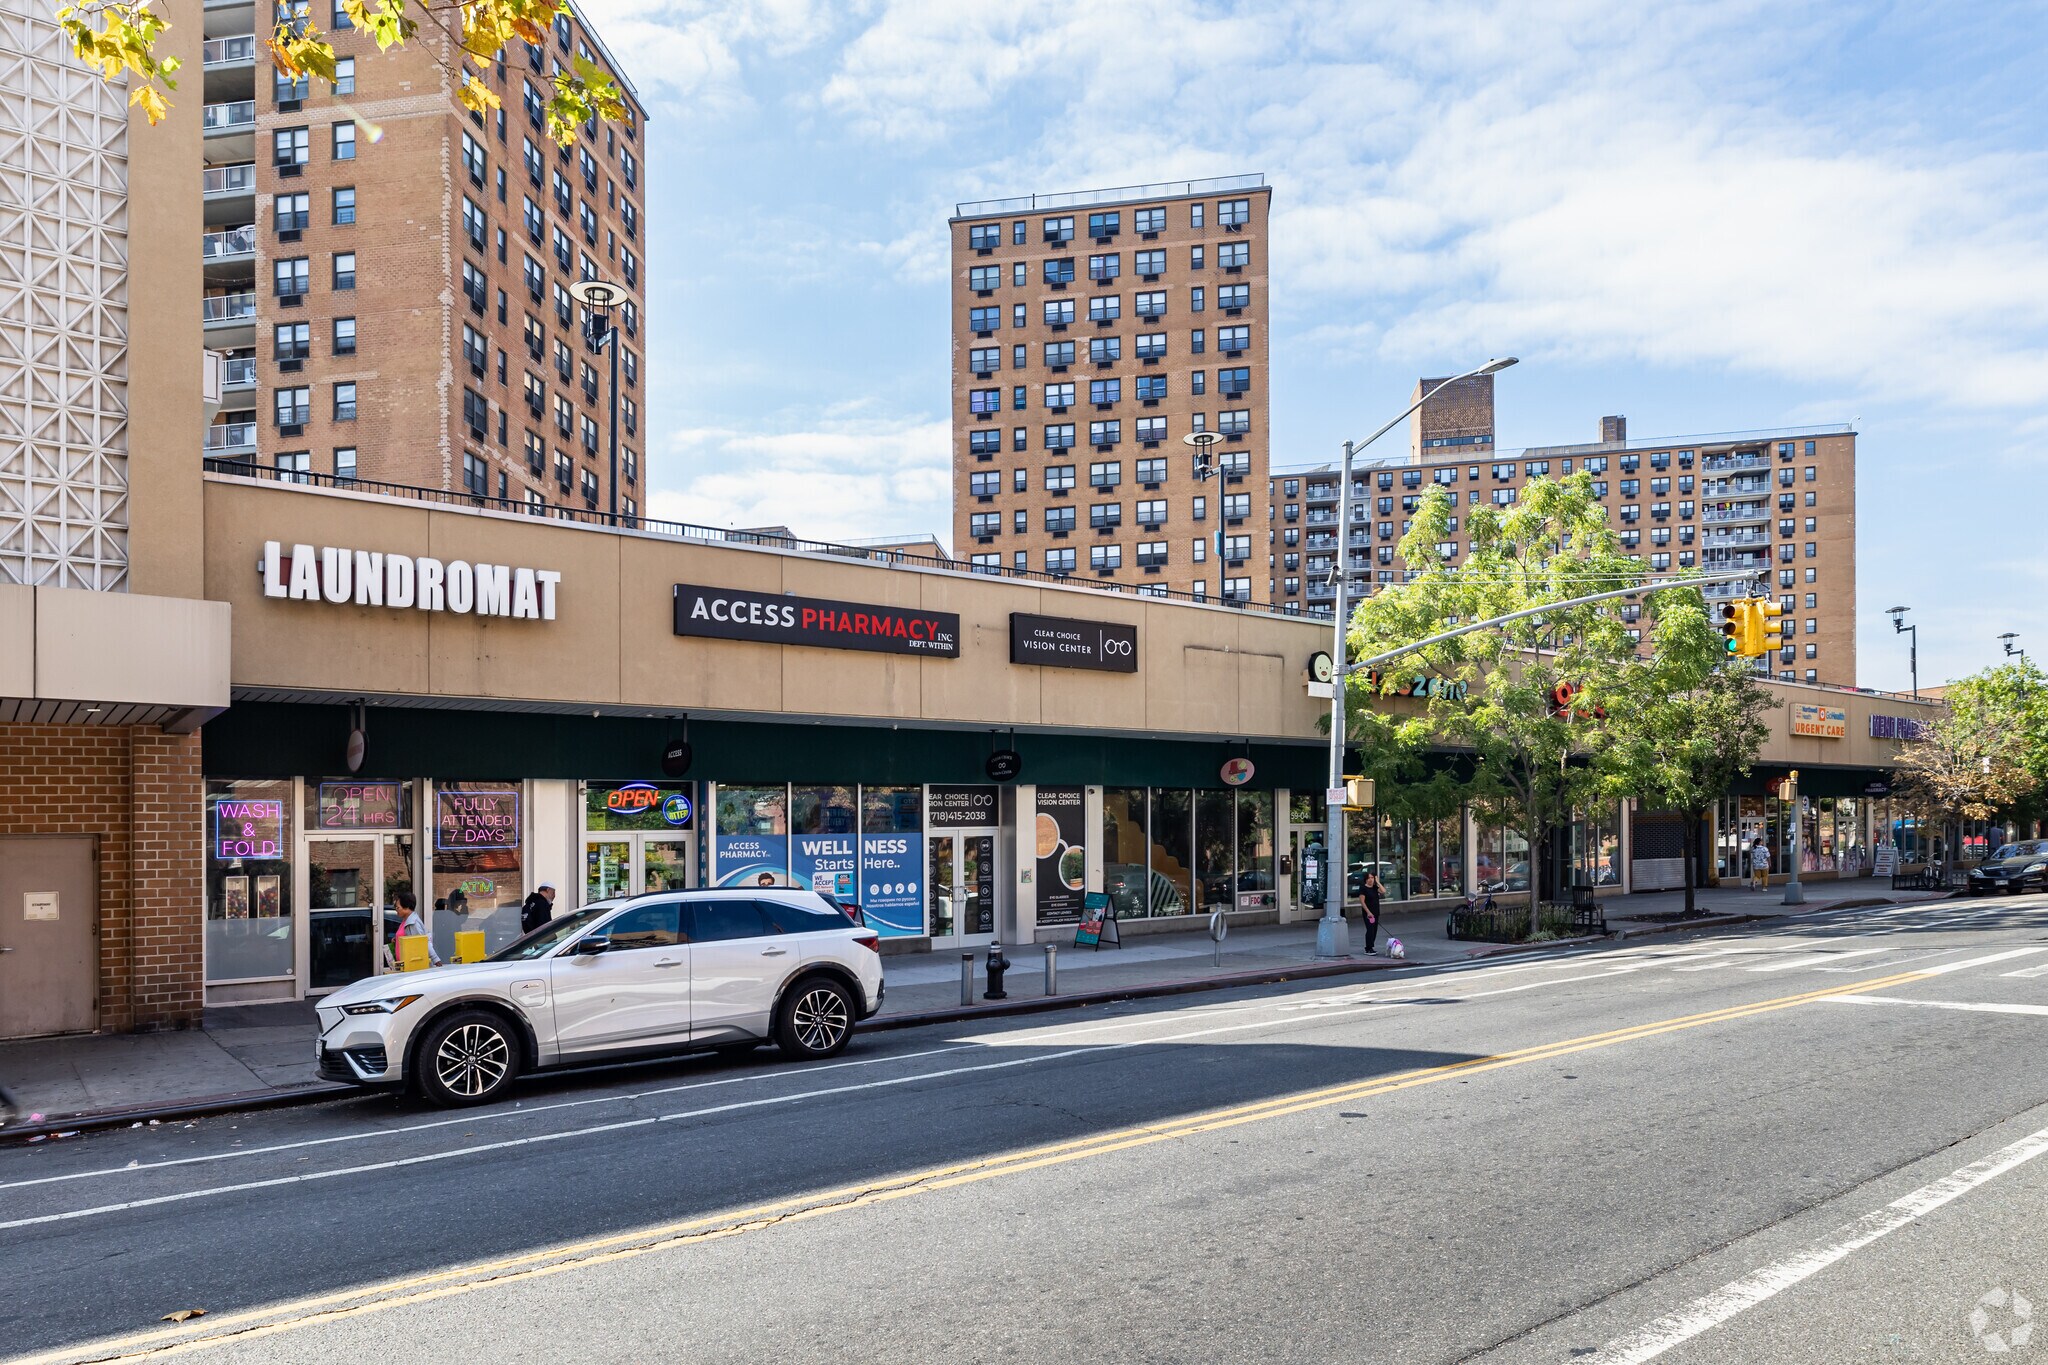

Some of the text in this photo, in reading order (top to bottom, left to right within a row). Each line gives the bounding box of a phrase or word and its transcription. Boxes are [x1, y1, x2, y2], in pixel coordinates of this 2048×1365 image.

[263, 540, 561, 621] LAUNDROMAT
[691, 597, 796, 628] ACCESS
[802, 608, 939, 642] PHARMACY
[1034, 629, 1081, 641] CLEAR CHOICE
[1023, 639, 1092, 655] VISION CENTER
[1795, 722, 1845, 737] URGENT CARE
[333, 786, 390, 802] OPEN
[607, 789, 659, 809] OPEN
[220, 803, 279, 818] WASH
[454, 797, 497, 811] FULLY
[325, 805, 395, 826] 24 HRS
[441, 814, 513, 827] ATTENDED
[243, 822, 256, 837] &
[449, 829, 505, 842] 7 DAYS
[222, 840, 276, 856] FOLD
[728, 841, 759, 850] ACCESS
[802, 839, 907, 856] WELL NESS
[720, 850, 768, 858] PHARMACY
[815, 858, 900, 870] Starts Here..
[459, 880, 494, 893] ATM
